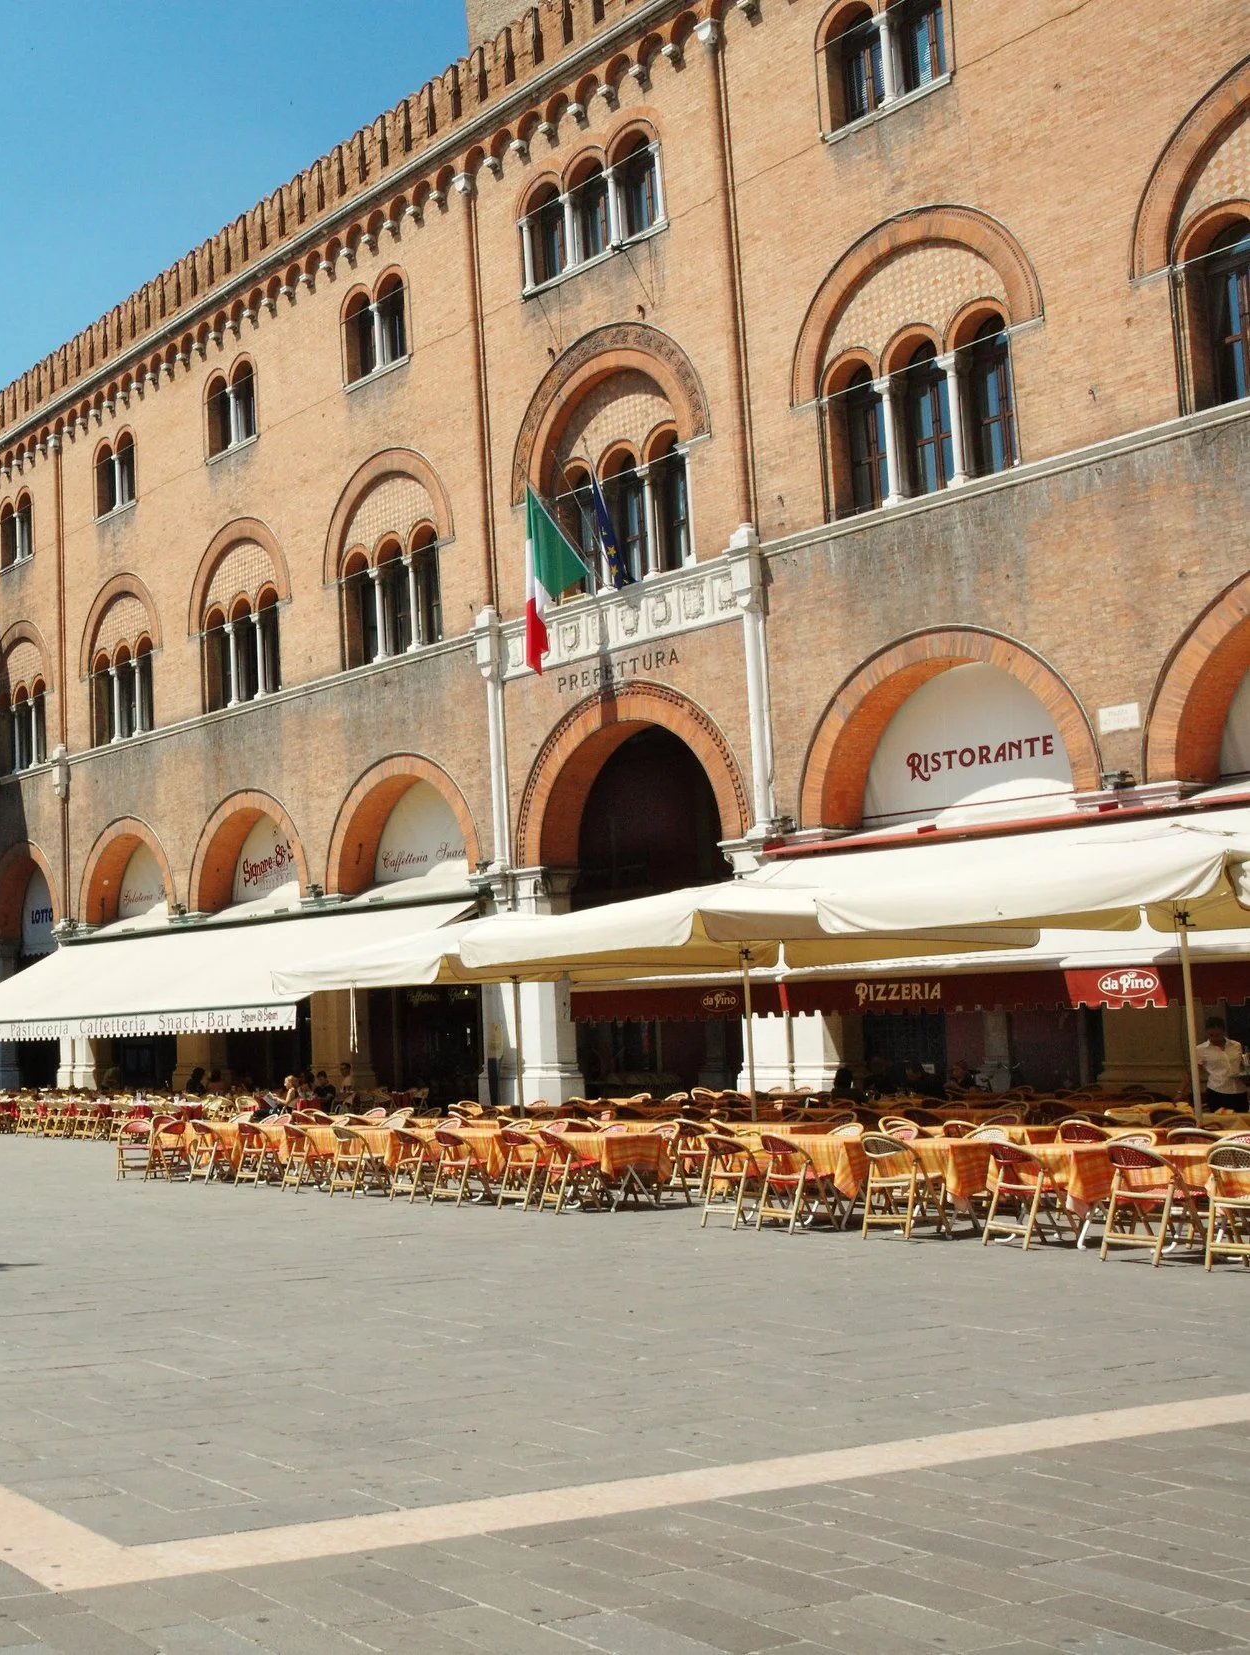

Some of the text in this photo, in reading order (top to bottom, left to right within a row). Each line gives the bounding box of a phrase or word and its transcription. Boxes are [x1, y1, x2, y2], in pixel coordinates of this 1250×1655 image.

[558, 648, 680, 693] PREFETTURA
[906, 734, 1054, 782] RISTORANTE
[382, 850, 428, 873] Caffetteria
[31, 908, 54, 925] LOTTO
[854, 982, 941, 1007] PIZZERIA
[1101, 974, 1154, 994] da Pino
[703, 994, 736, 1008] da Pino
[10, 1022, 69, 1036] Pasticceria
[80, 1016, 146, 1033] Caffetteria
[158, 1011, 232, 1029] Snack-Bar
